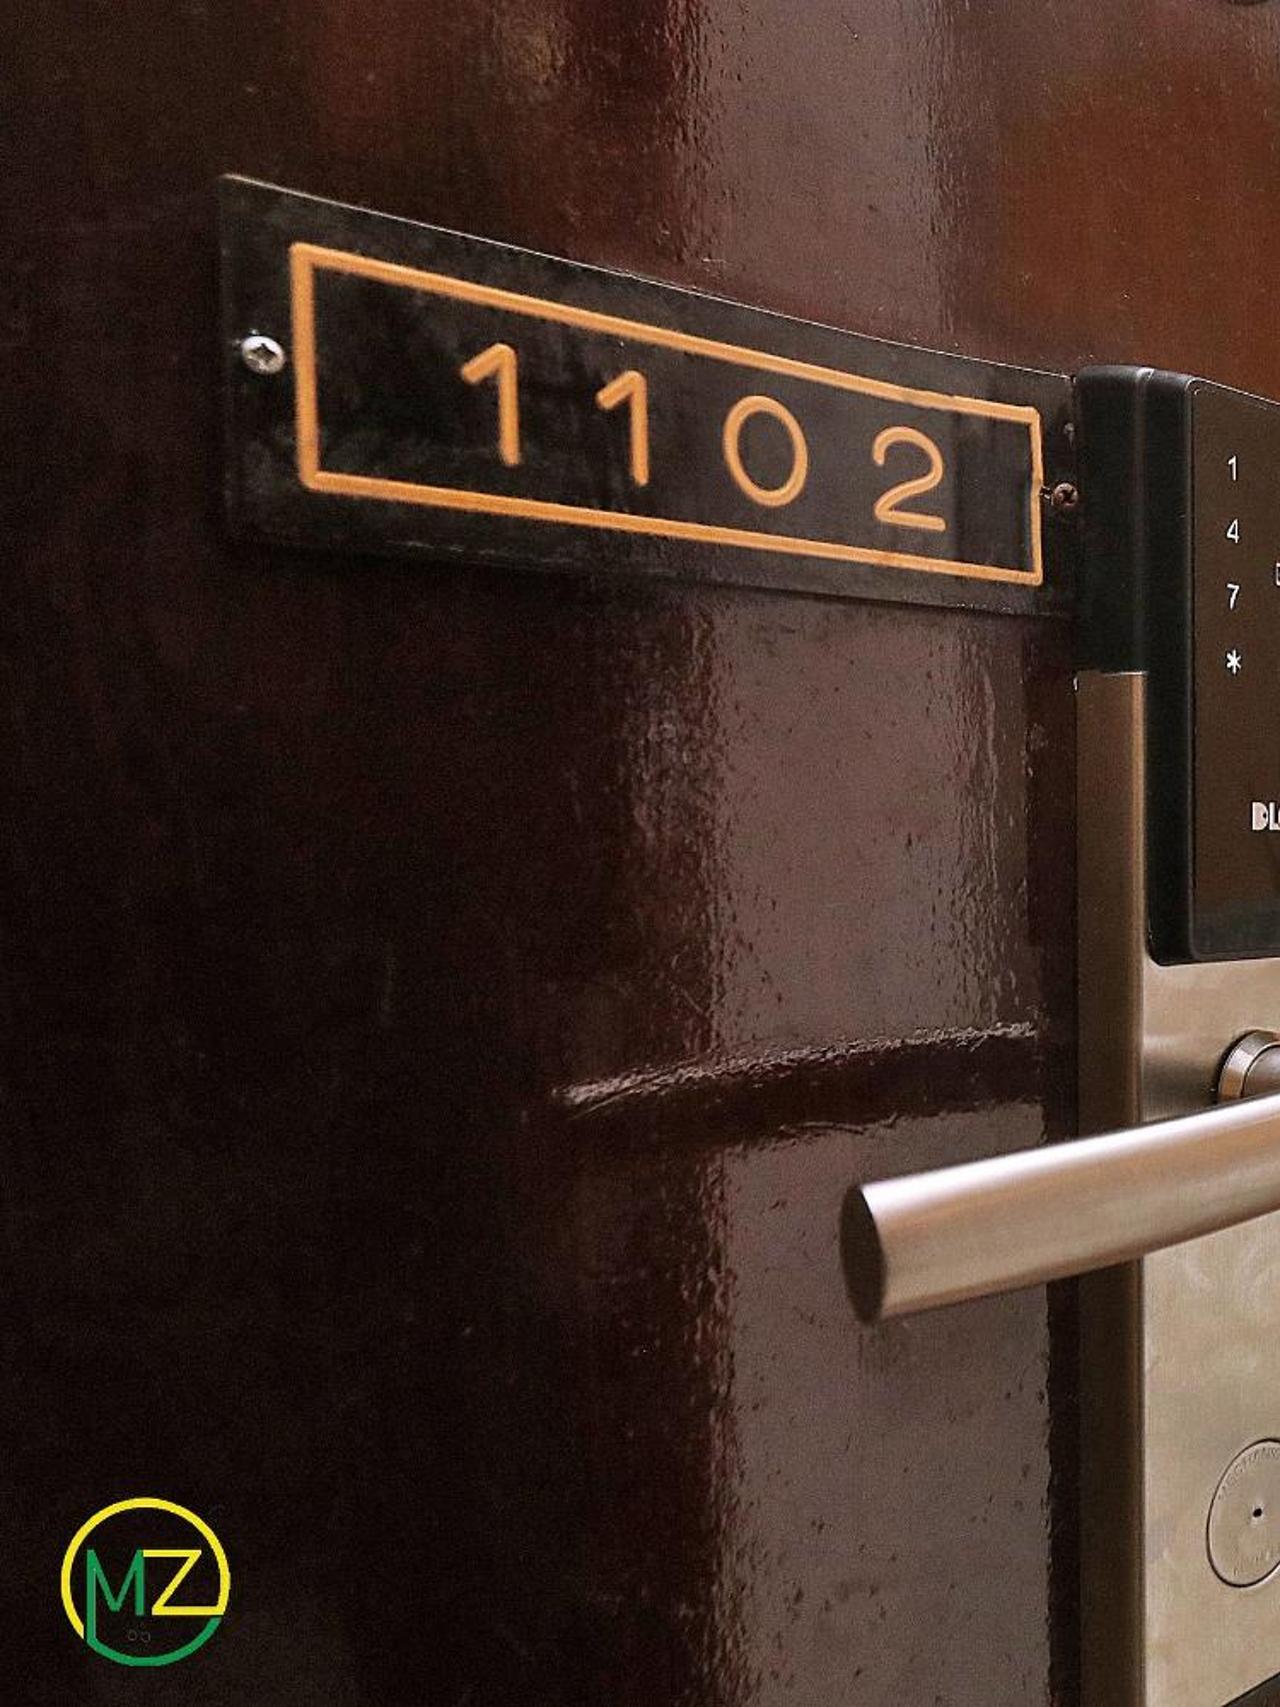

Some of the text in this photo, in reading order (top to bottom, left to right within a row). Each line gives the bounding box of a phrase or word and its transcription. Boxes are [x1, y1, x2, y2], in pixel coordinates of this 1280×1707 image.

[461, 343, 946, 531] 1102
[1227, 455, 1237, 481] 1
[1226, 518, 1240, 544] 4
[1226, 583, 1240, 610] 7
